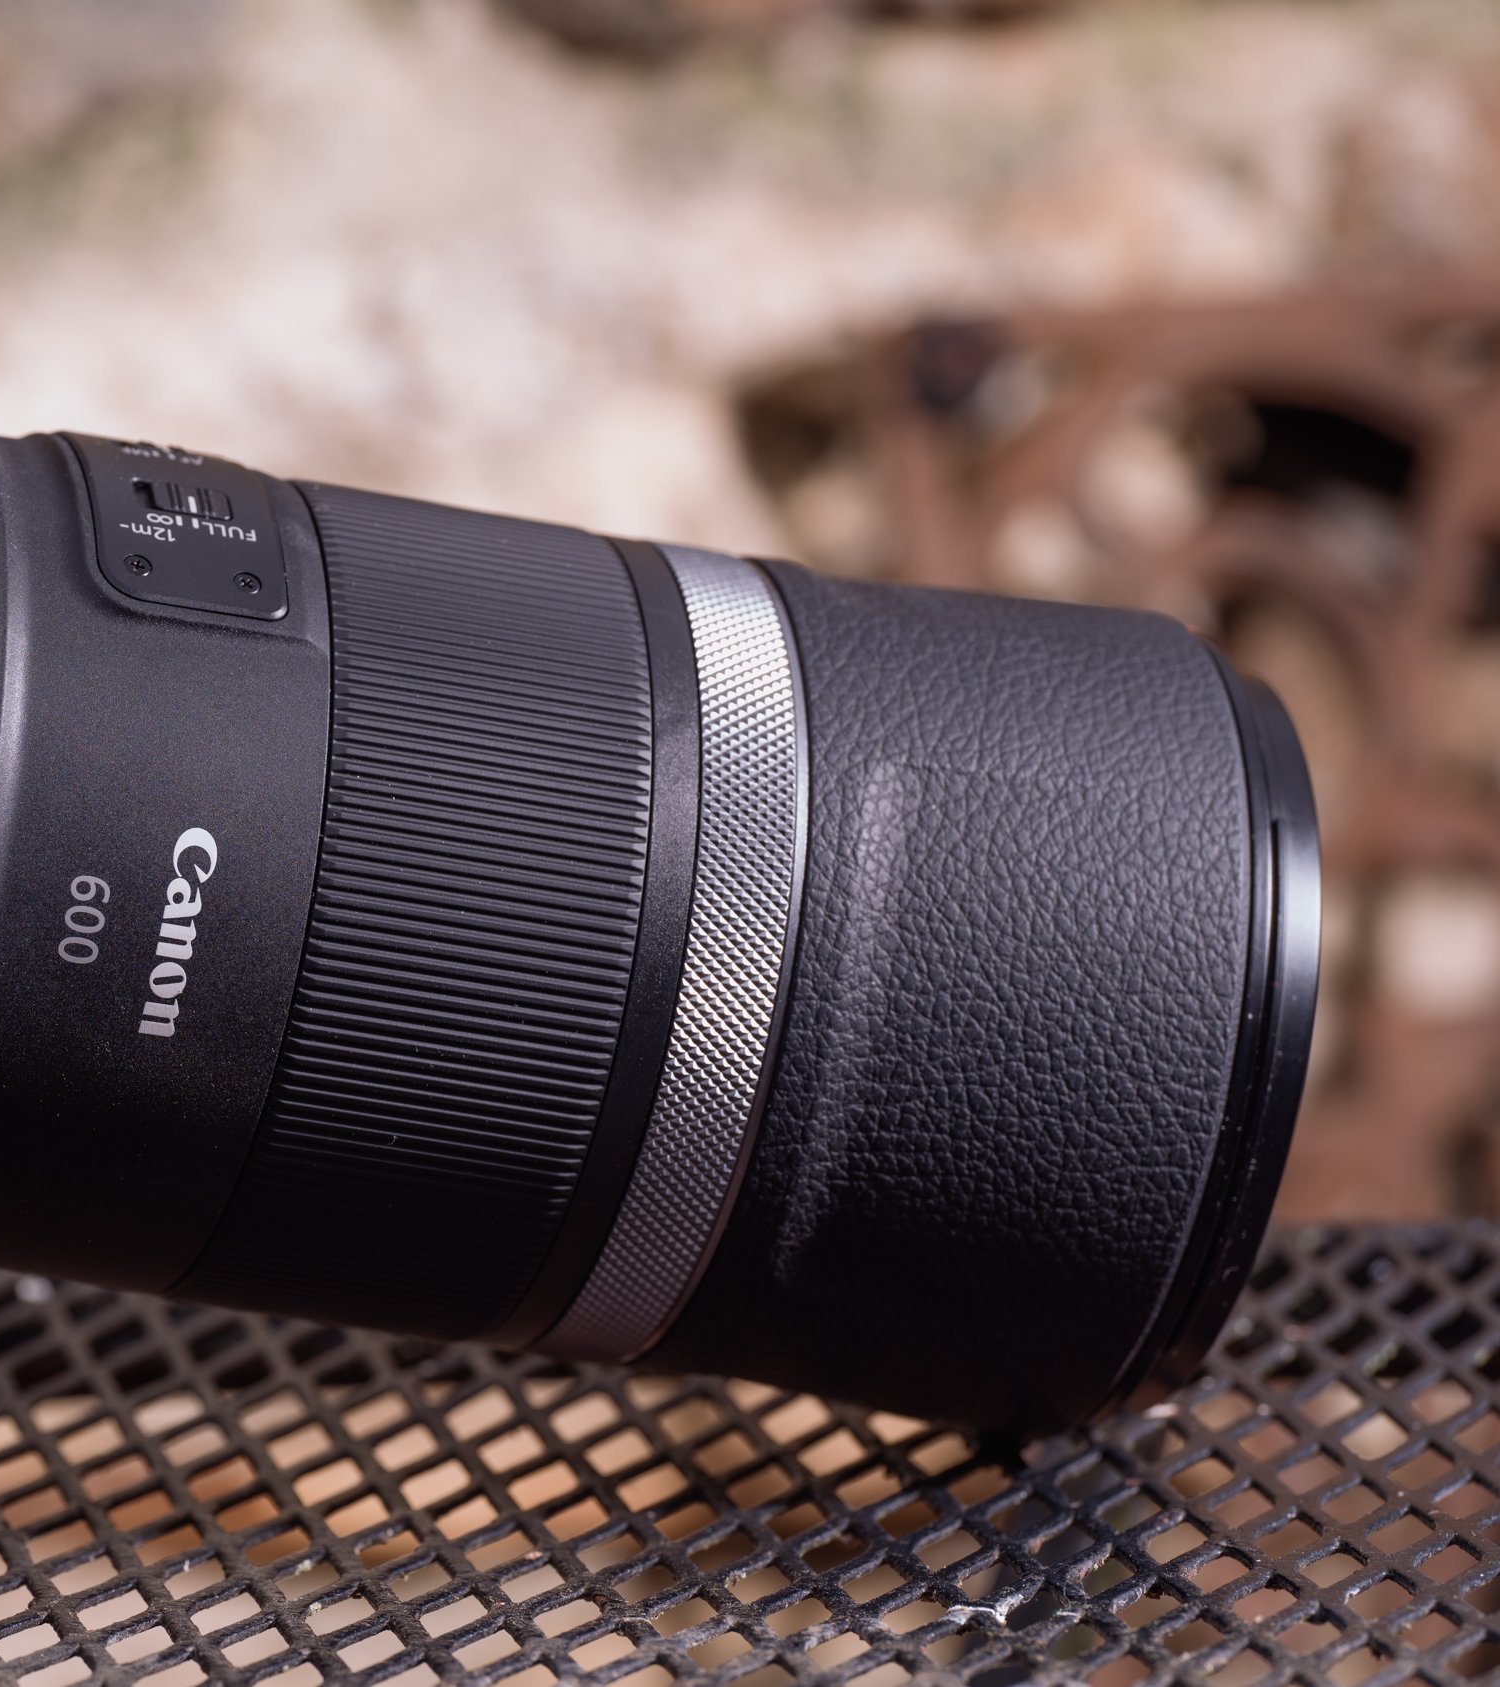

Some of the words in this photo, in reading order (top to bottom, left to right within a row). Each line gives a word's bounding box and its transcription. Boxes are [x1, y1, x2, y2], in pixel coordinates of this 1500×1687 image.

[201, 521, 257, 543] FULL
[57, 874, 111, 965] 600
[138, 827, 218, 1038] Canon
